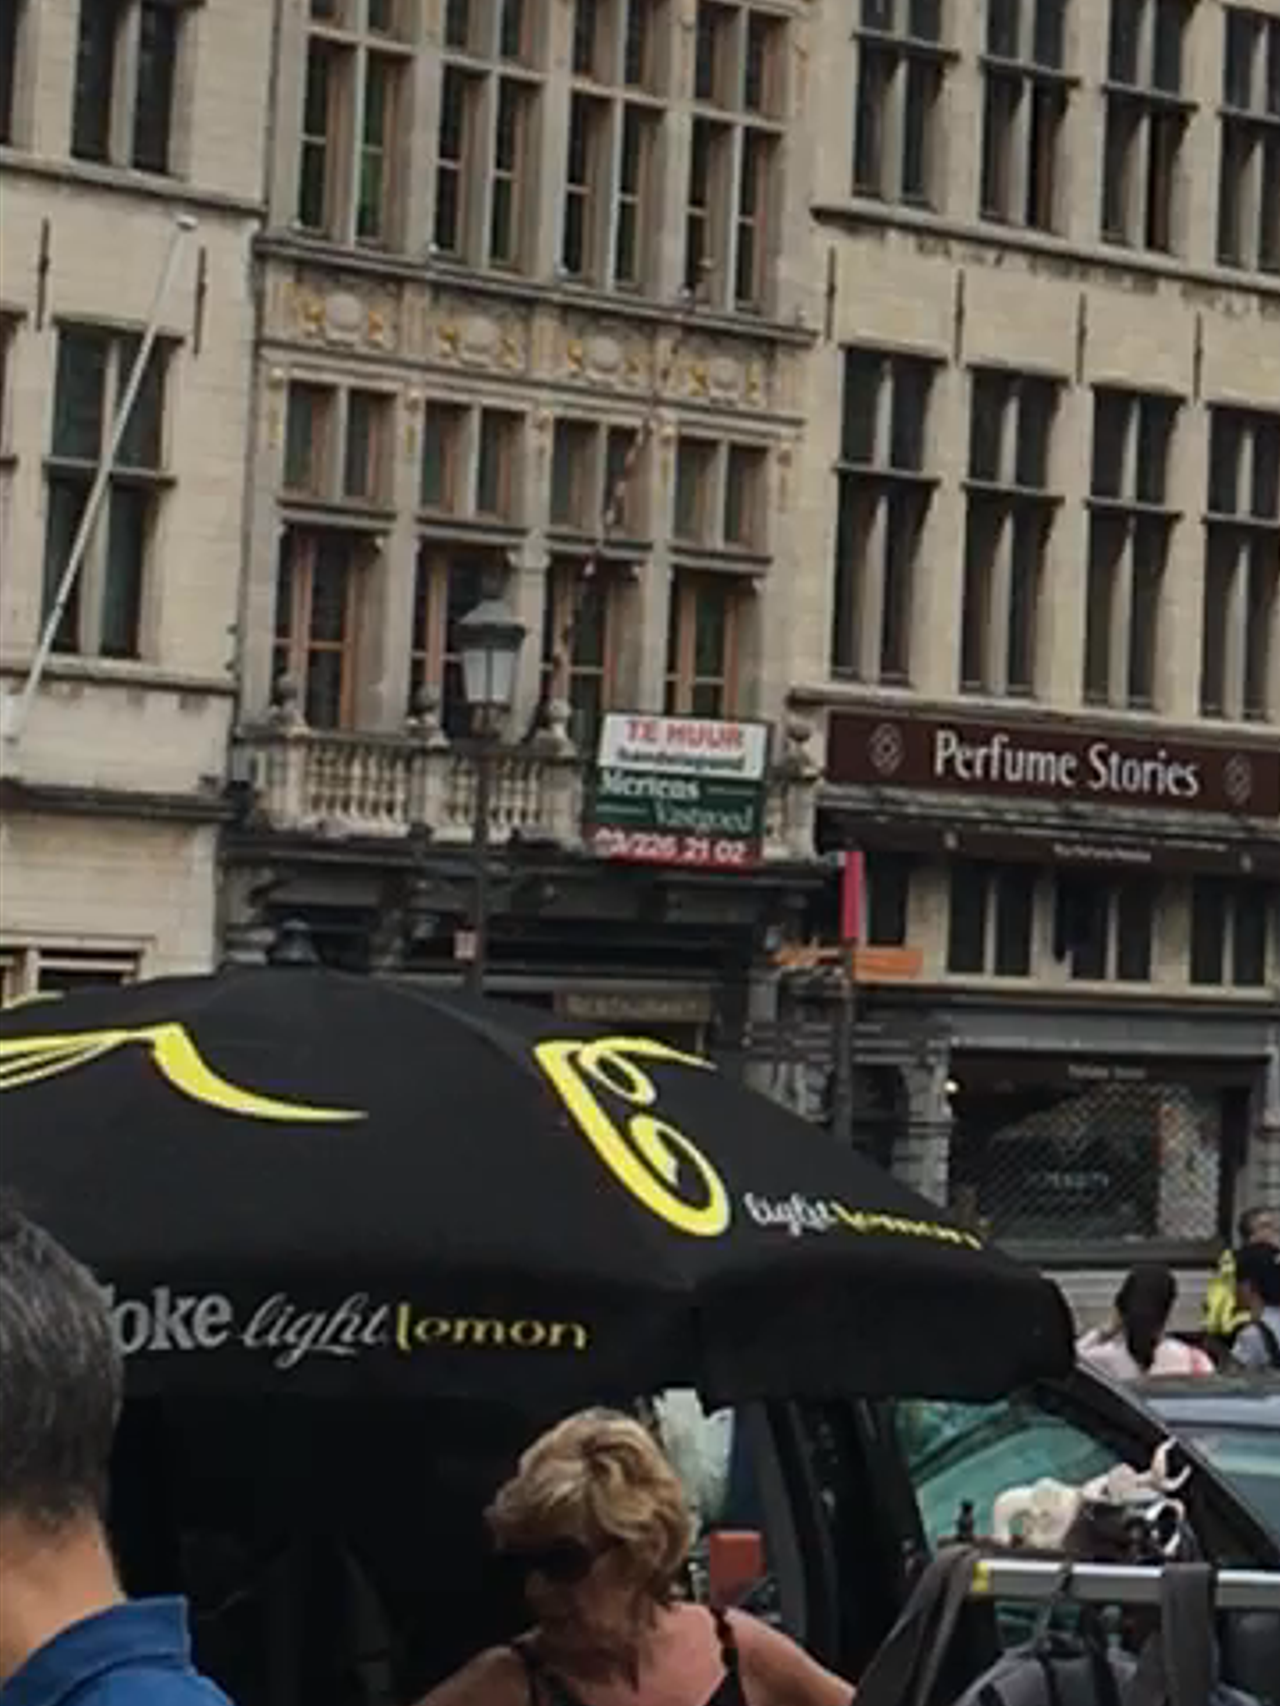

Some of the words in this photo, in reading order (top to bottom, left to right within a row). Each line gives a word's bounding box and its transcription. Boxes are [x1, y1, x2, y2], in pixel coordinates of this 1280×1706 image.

[626, 717, 657, 743] TE
[666, 722, 745, 751] HUUR
[934, 729, 1078, 786] Perfume
[1089, 743, 1199, 797] Stories
[242, 1290, 391, 1369] light
[395, 1300, 589, 1352] lemon
